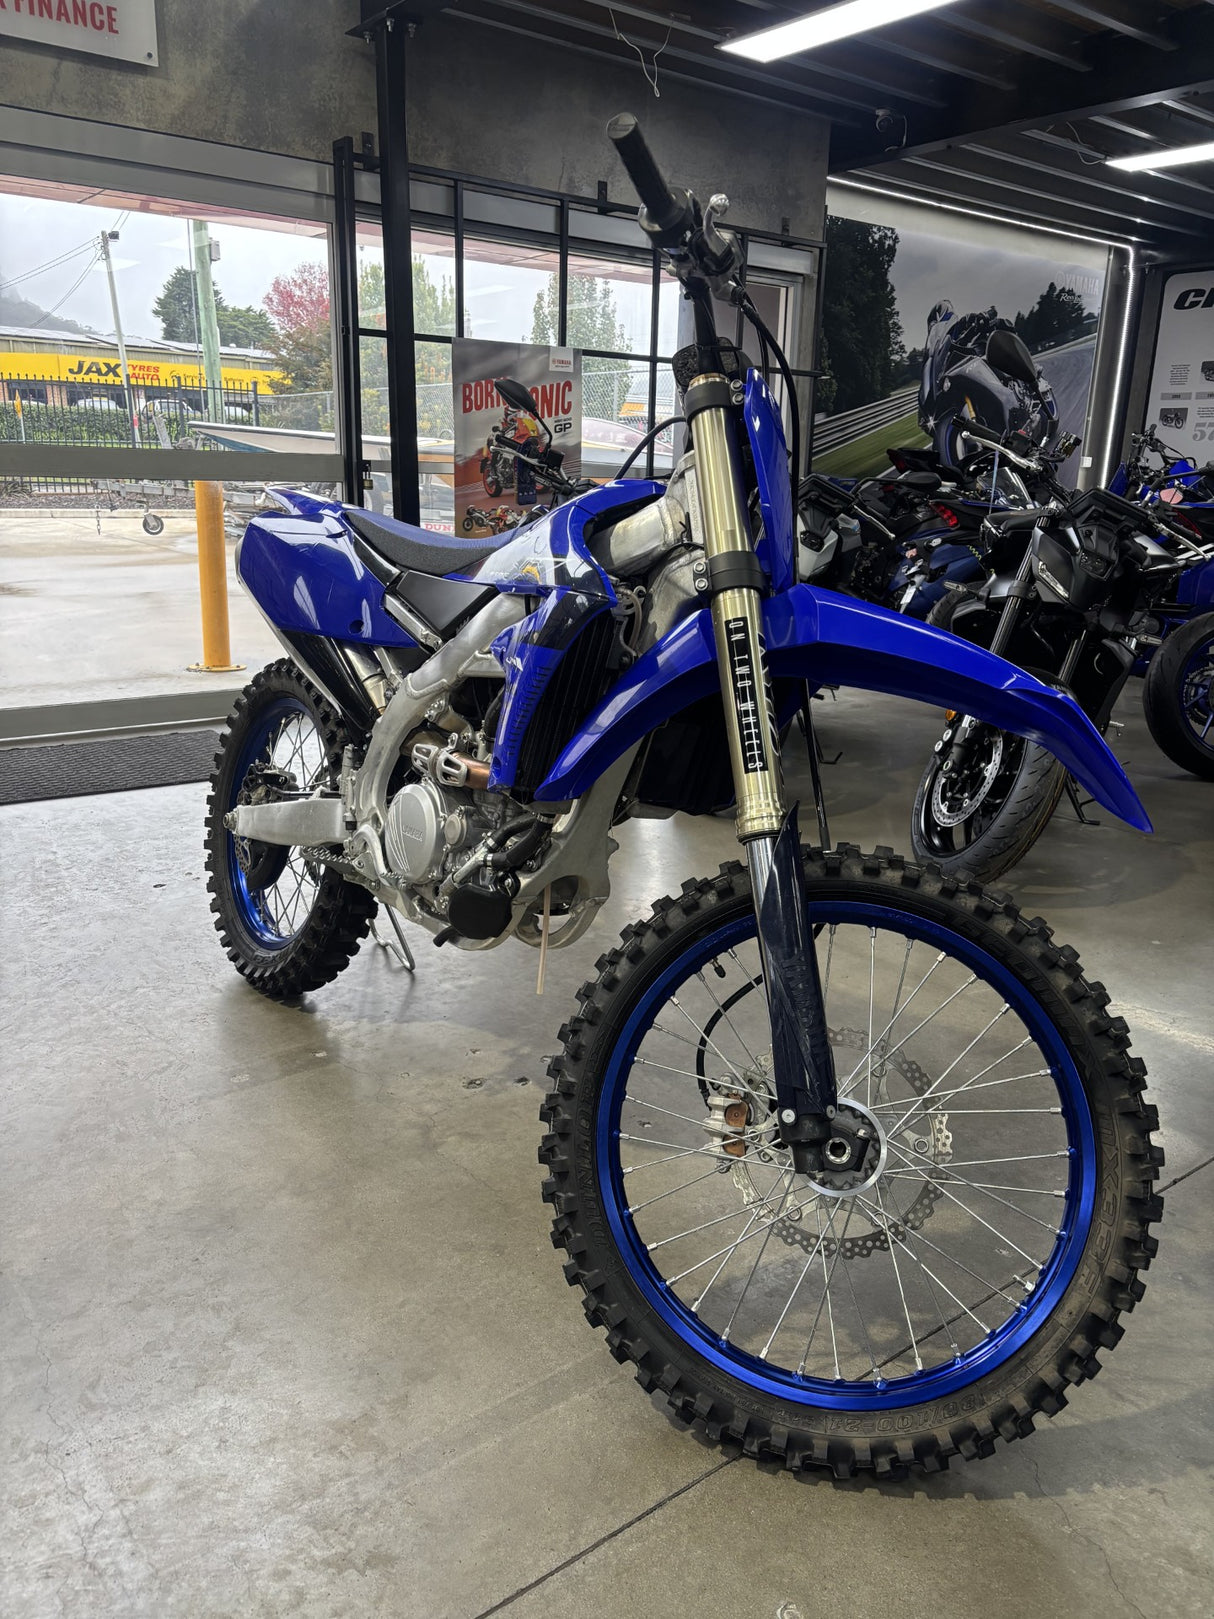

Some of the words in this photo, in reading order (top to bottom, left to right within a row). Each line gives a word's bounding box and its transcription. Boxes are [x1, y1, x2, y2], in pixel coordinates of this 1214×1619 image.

[68, 360, 121, 378] JAX
[130, 372, 160, 381] AUTO
[522, 380, 573, 421] ONIC
[554, 422, 573, 433] GP
[425, 523, 455, 532] DUN
[729, 621, 745, 641] ON
[734, 654, 751, 688] TWO
[740, 700, 763, 769] WHEELS
